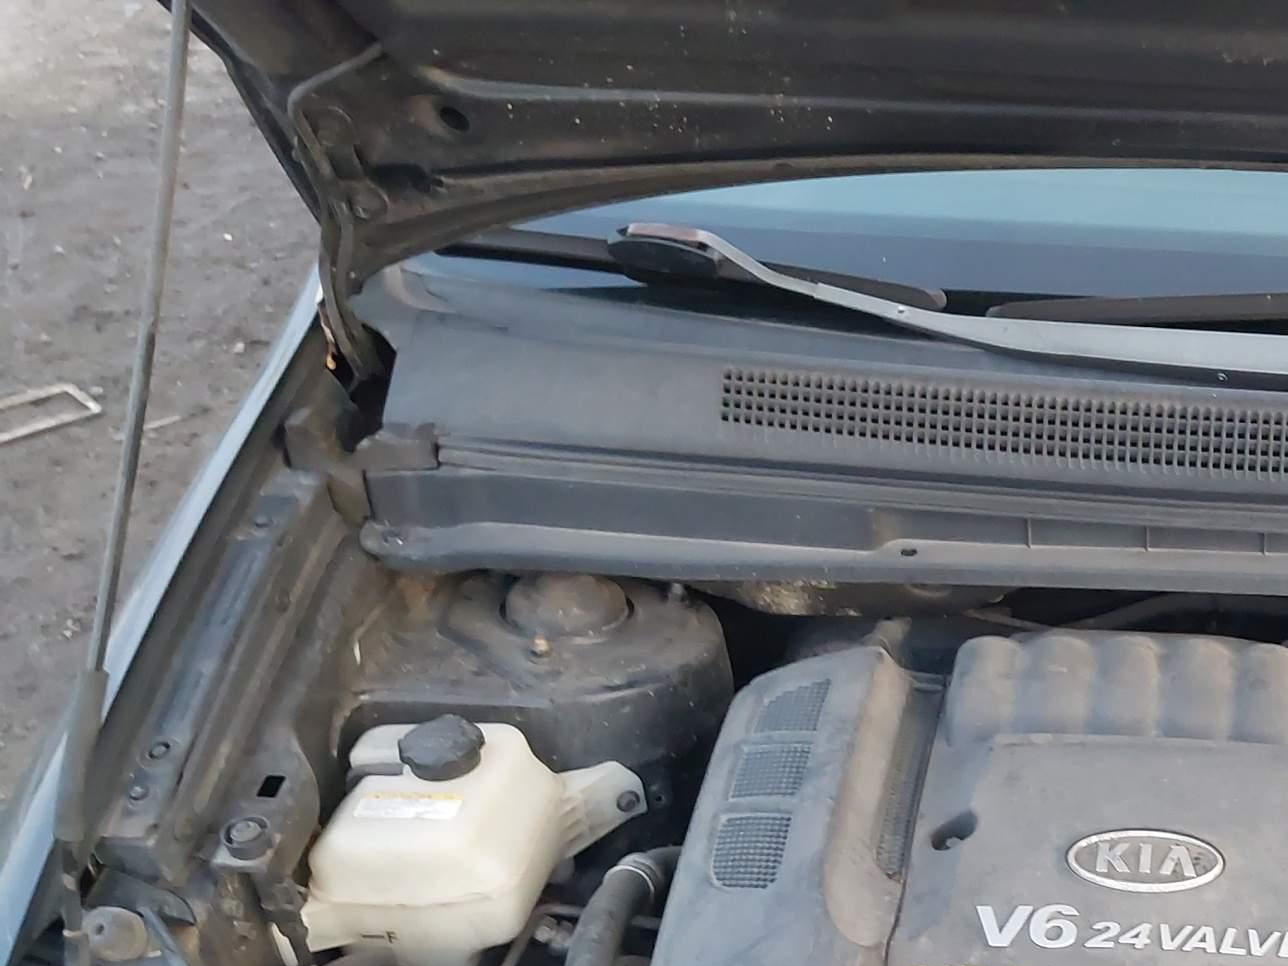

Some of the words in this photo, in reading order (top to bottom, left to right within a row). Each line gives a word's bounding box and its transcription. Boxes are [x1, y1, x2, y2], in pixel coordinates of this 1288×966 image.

[1095, 842, 1198, 878] KIA
[975, 903, 1081, 949] V6
[1084, 920, 1153, 950] 24
